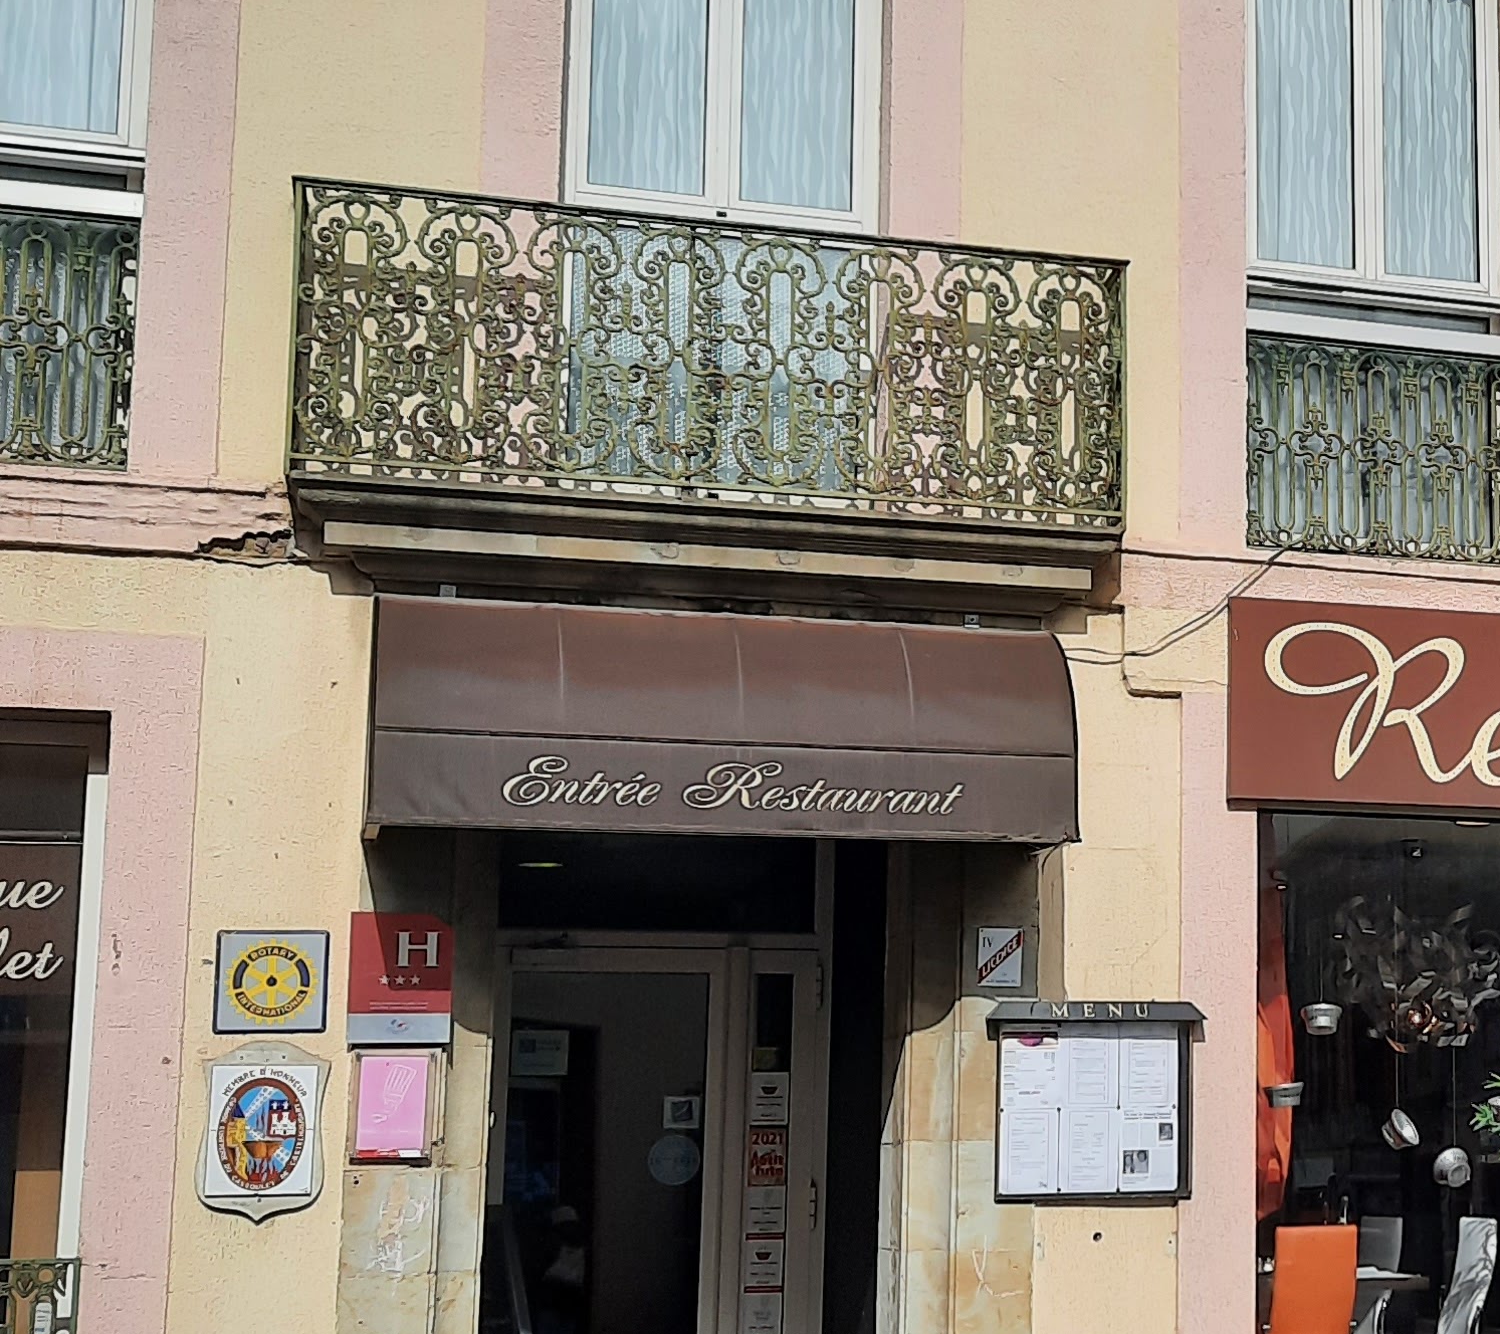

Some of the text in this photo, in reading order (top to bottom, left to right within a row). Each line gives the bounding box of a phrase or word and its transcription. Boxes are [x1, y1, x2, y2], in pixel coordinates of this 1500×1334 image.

[501, 755, 965, 816] Entrée Restaurant
[395, 930, 443, 968] H
[982, 936, 994, 948] IV
[250, 947, 295, 961] ROTARY
[237, 991, 307, 1017] INTERNATIONAL
[1050, 1003, 1150, 1018] MENU
[751, 1132, 783, 1145] 2021
